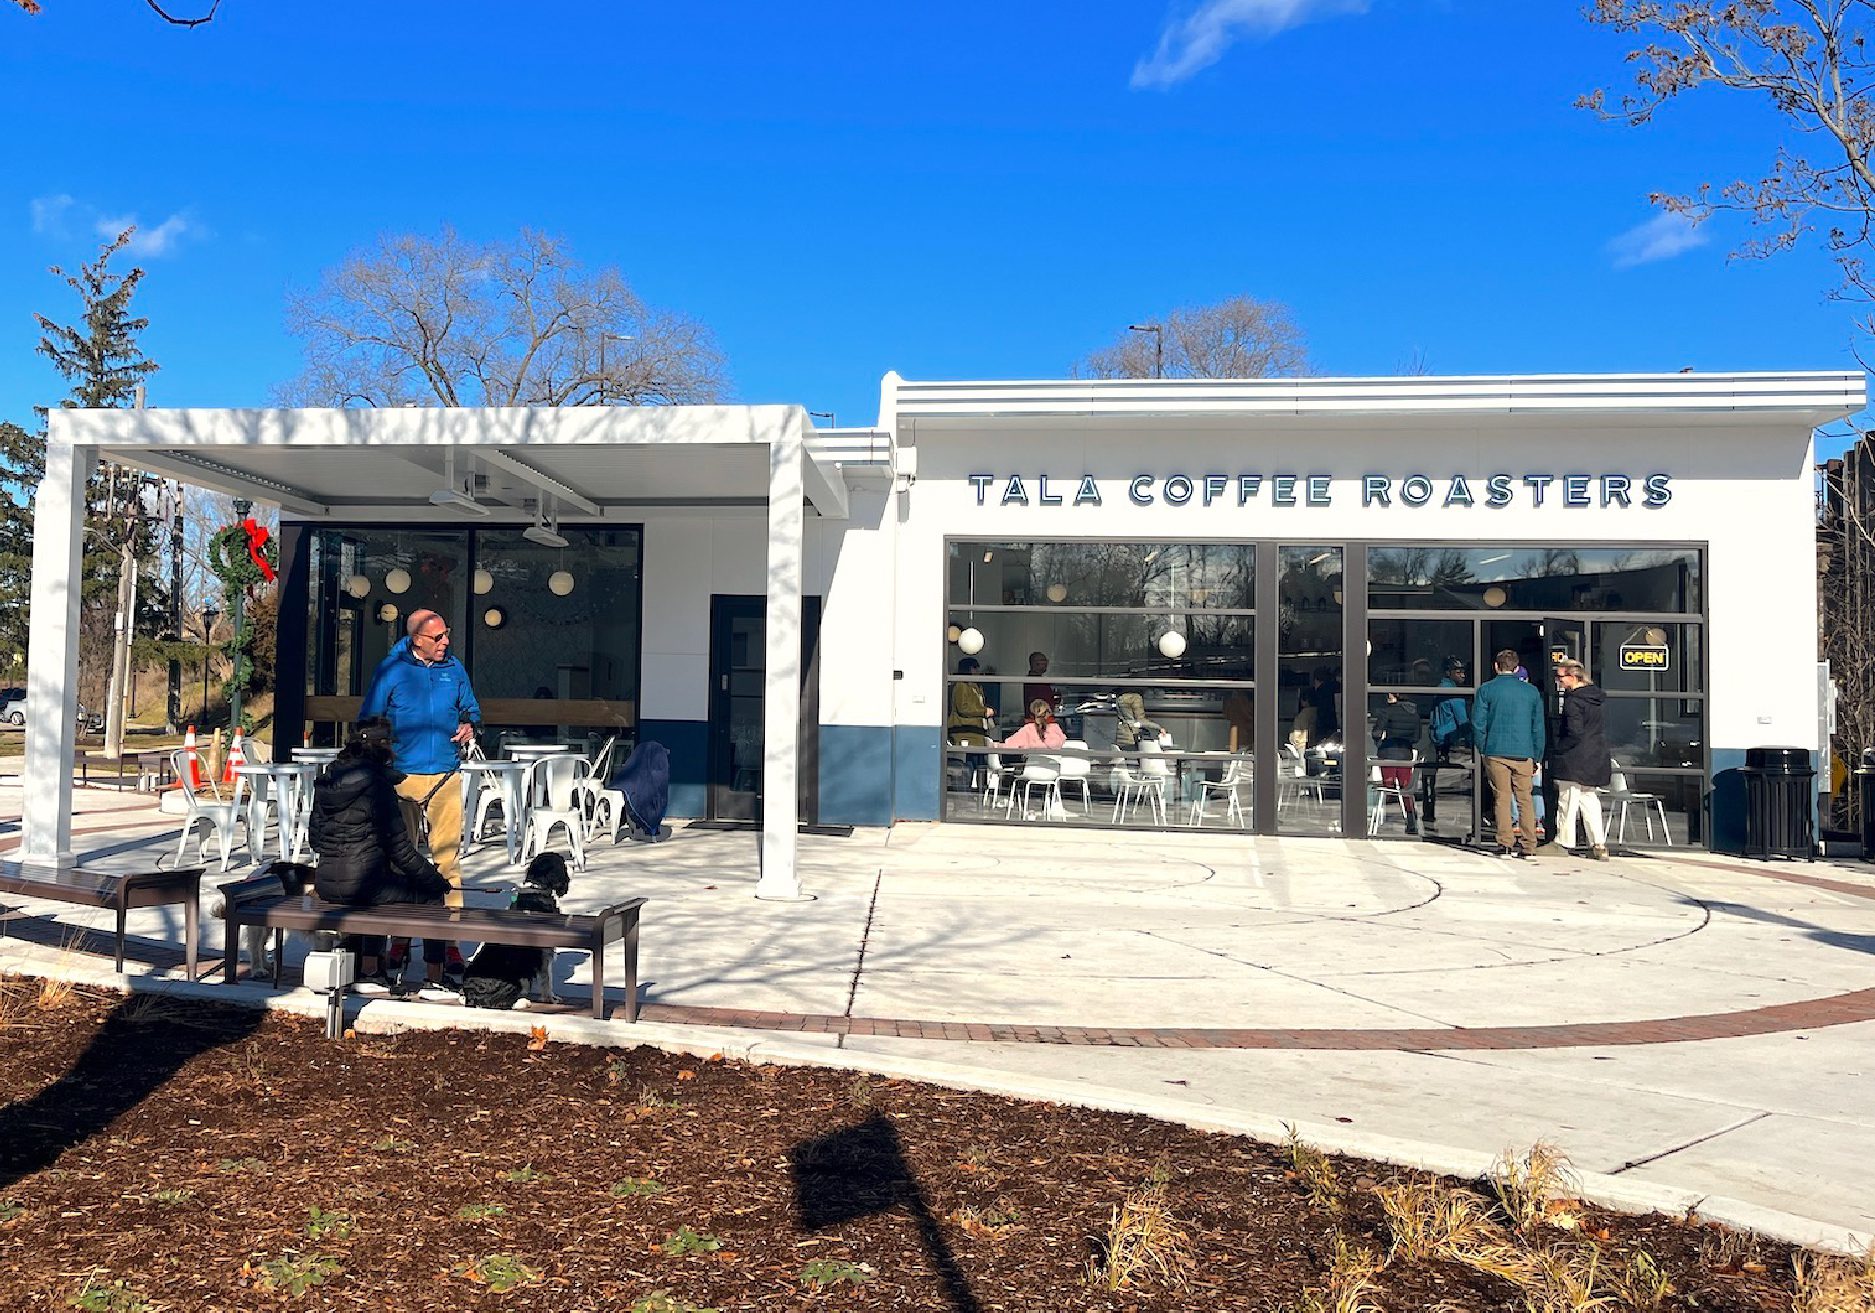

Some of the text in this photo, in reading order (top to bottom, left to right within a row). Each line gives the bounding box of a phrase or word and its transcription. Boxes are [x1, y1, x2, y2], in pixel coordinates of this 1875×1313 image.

[968, 474, 1673, 506] TALA COFFEE ROASTERS
[1624, 651, 1664, 664] OPEN
